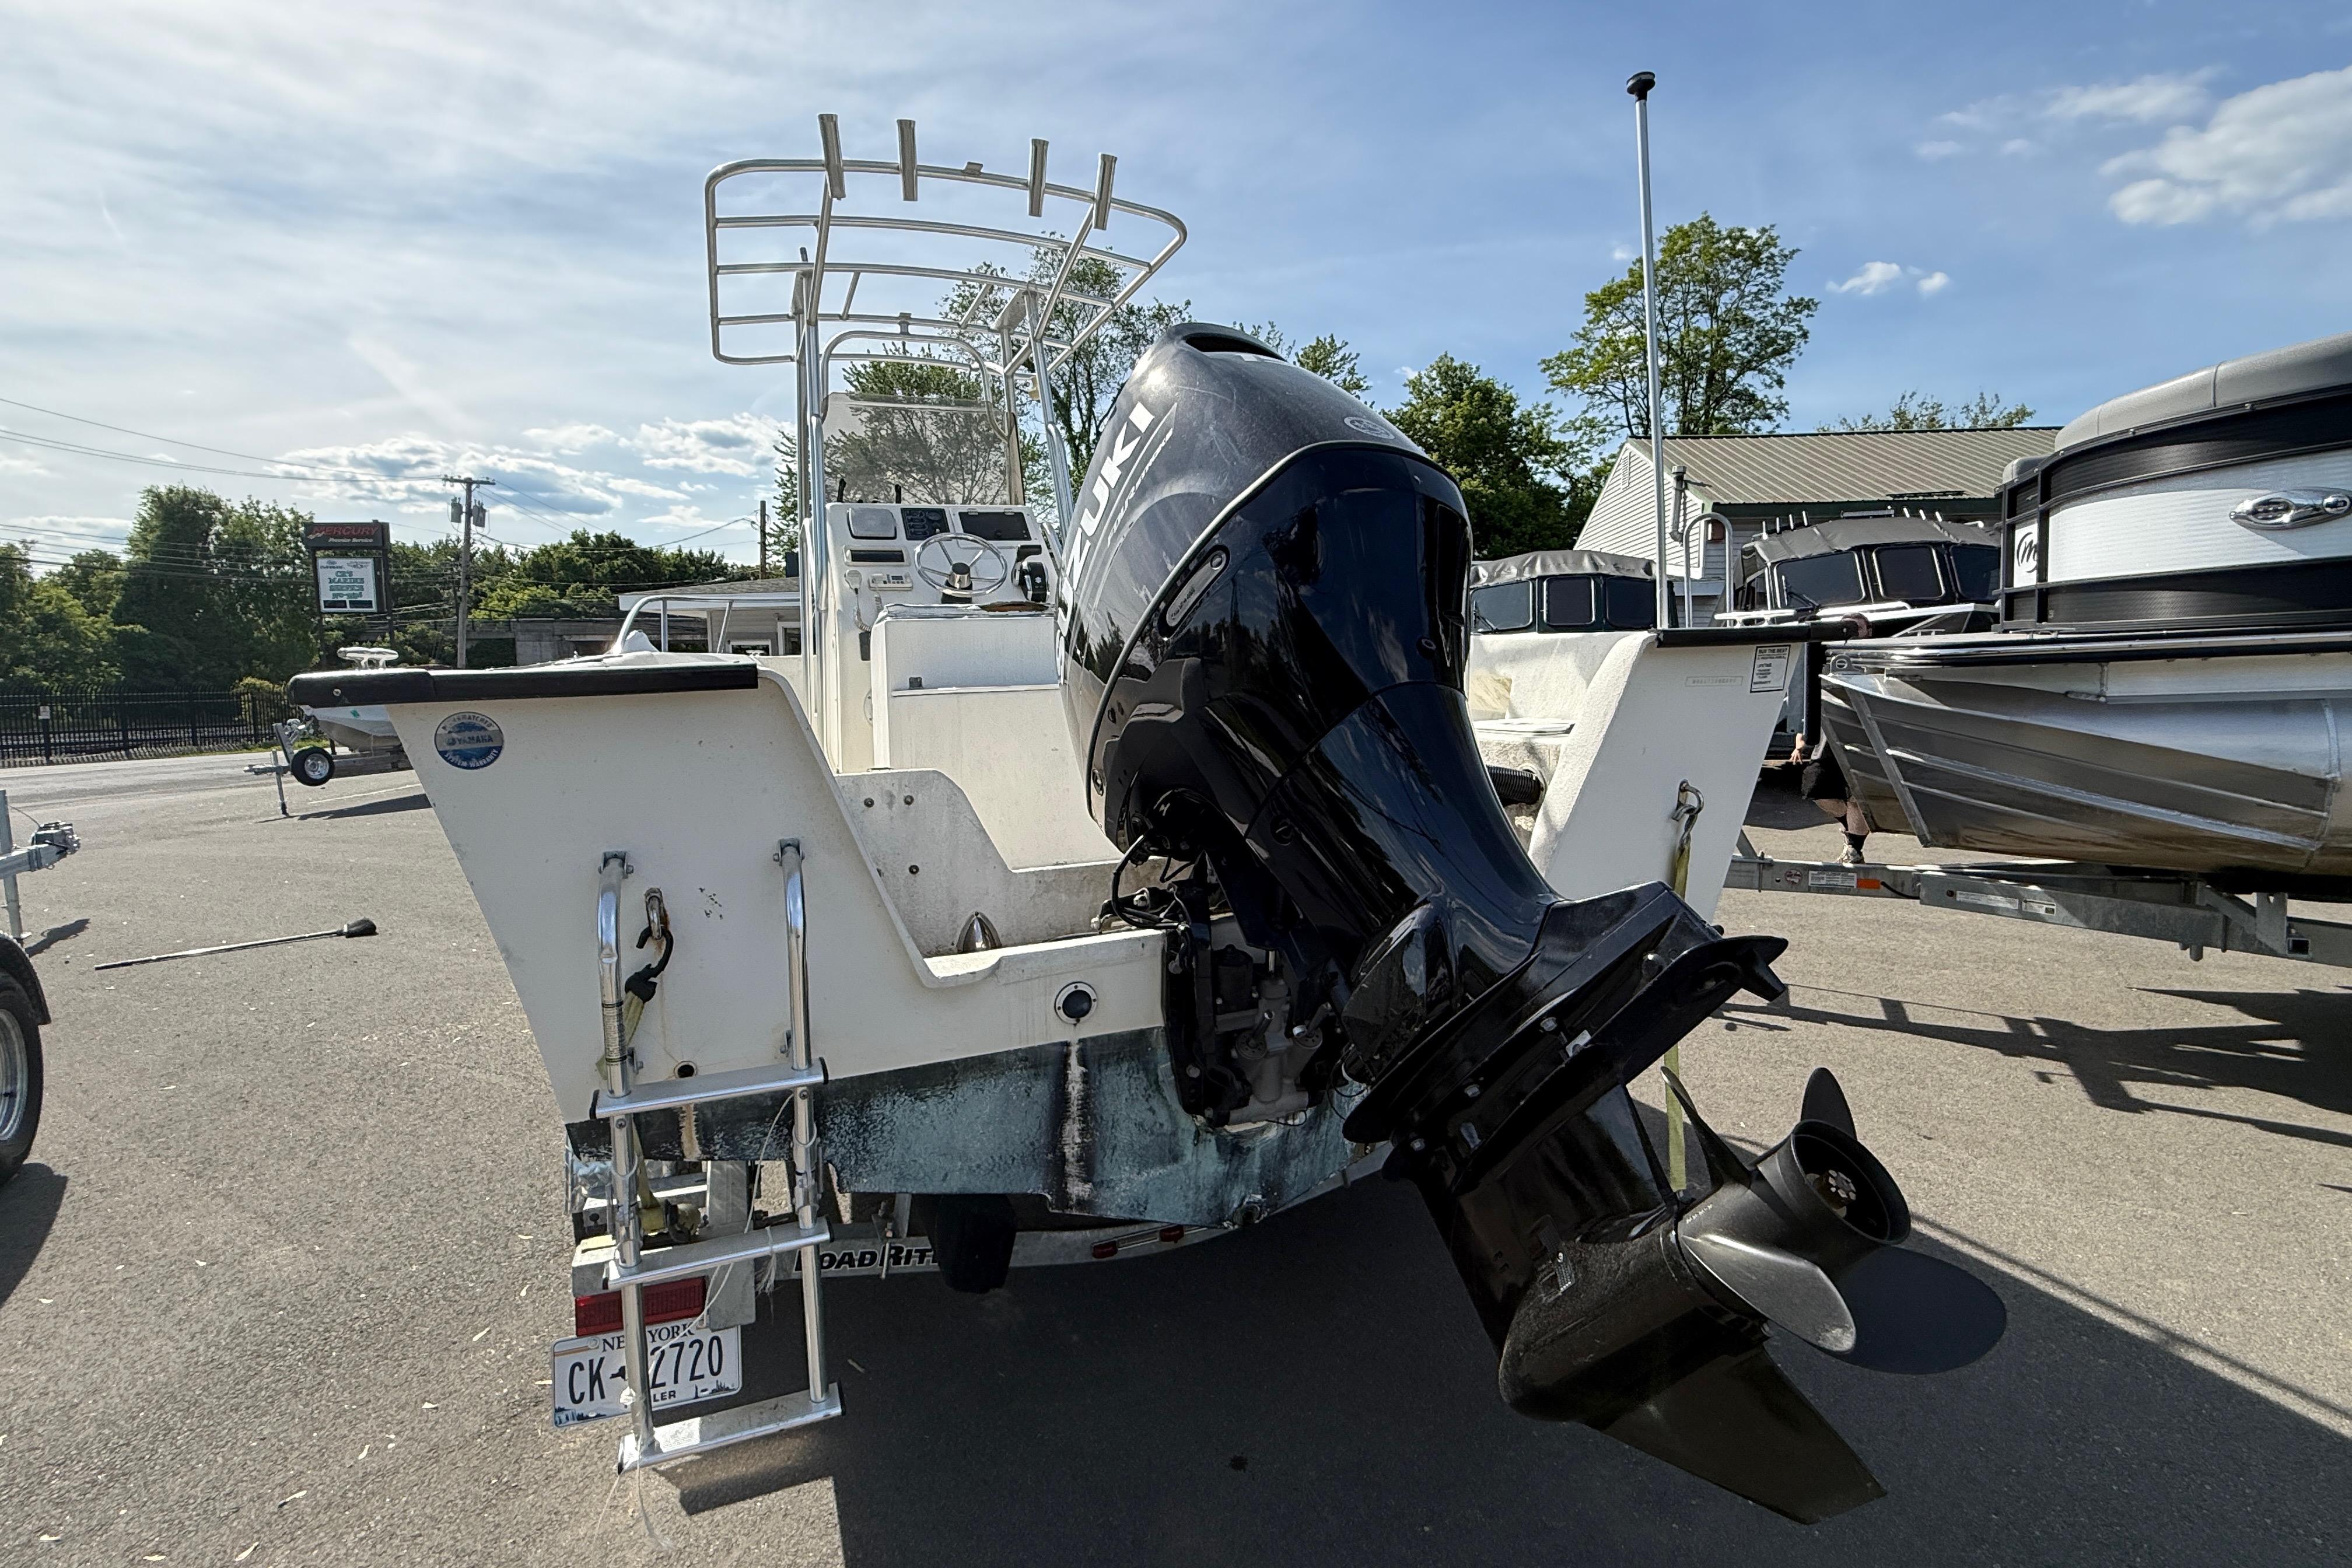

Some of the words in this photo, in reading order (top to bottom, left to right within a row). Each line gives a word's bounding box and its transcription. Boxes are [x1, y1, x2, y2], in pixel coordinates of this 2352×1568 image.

[313, 526, 379, 536] MERCURY
[457, 735, 494, 744] YAMAHA
[469, 748, 499, 768] WARRANTY
[601, 1335, 625, 1353] NE
[647, 1321, 695, 1343] YORK
[568, 1356, 606, 1405] CK
